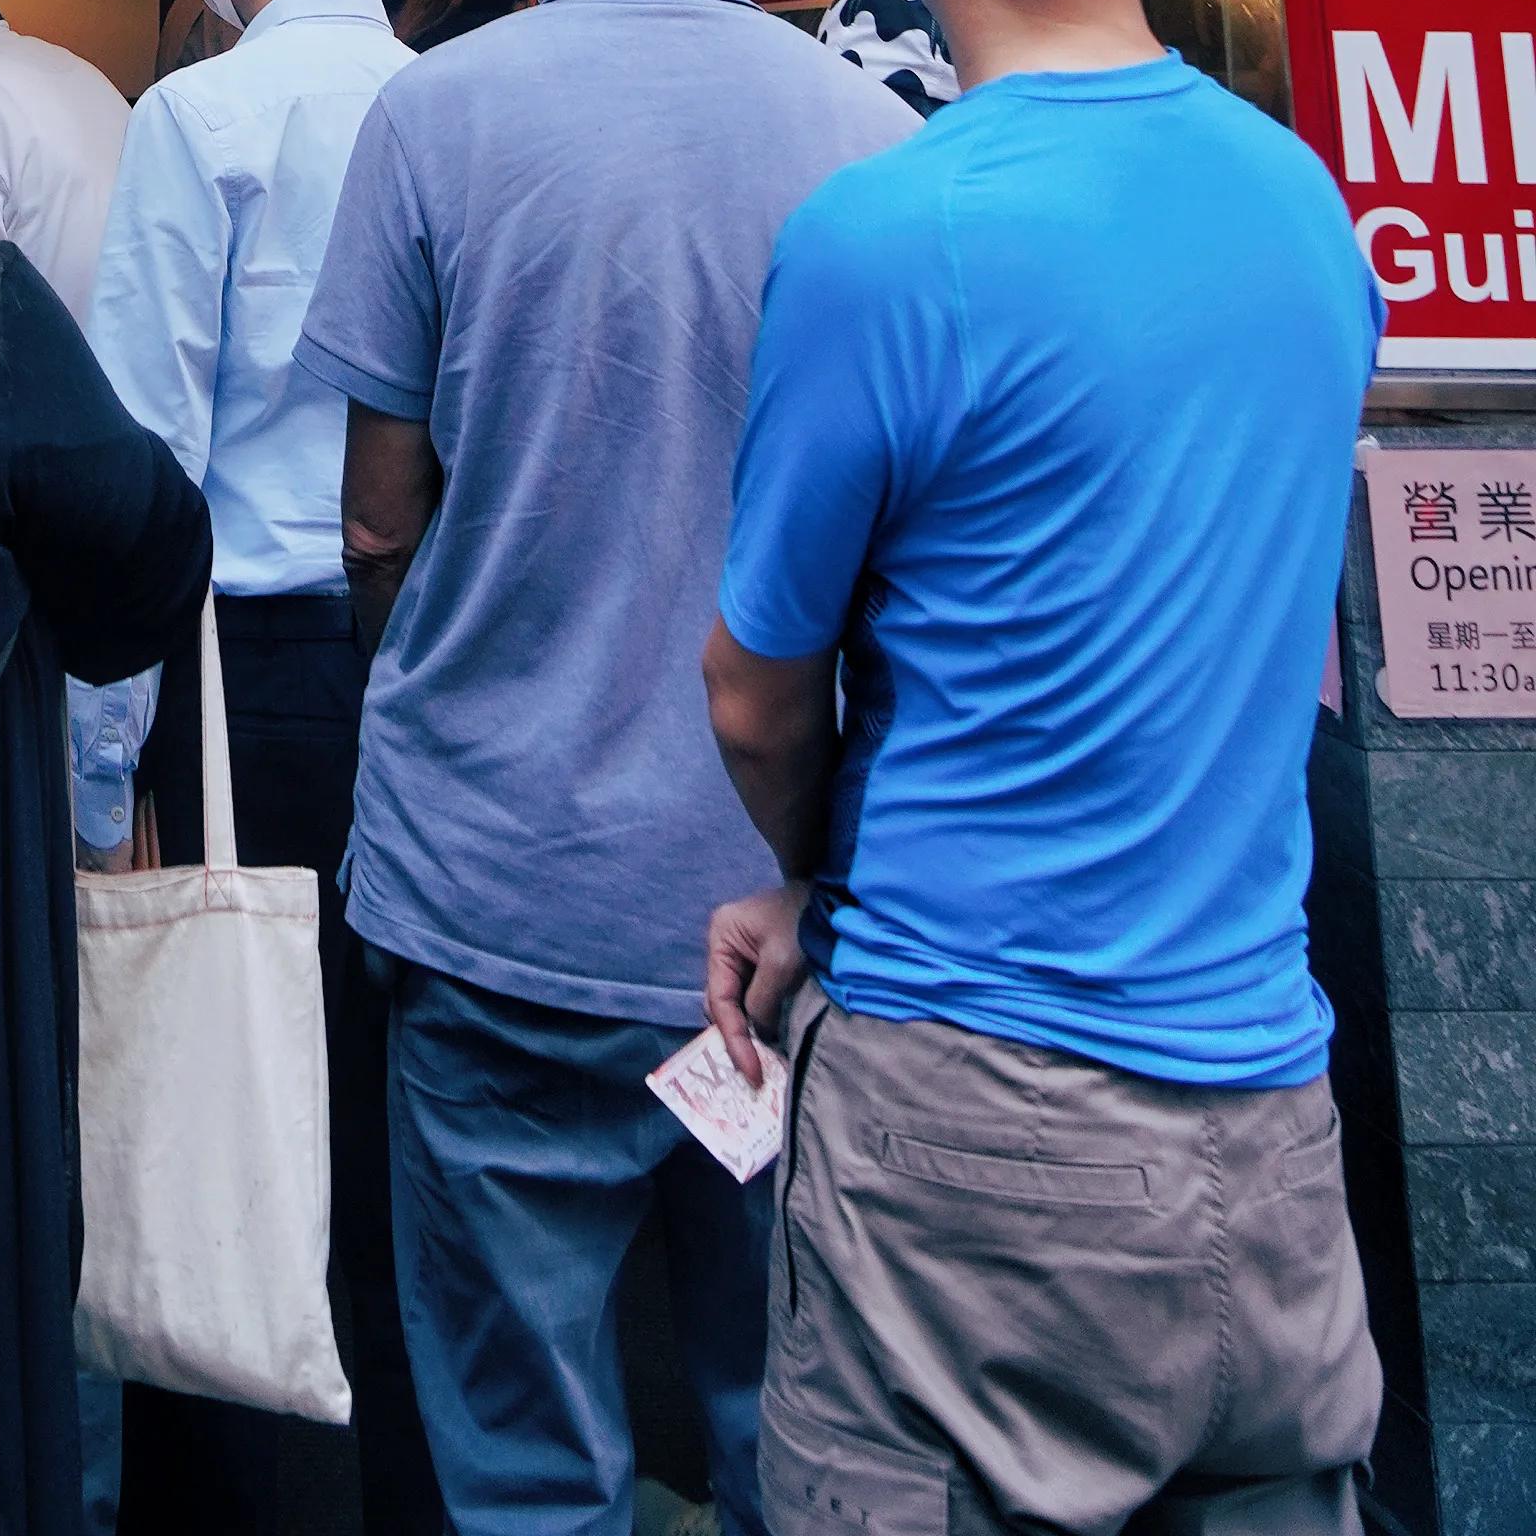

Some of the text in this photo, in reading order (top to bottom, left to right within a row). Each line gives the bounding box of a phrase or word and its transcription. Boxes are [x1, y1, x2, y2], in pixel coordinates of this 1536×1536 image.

[1354, 206, 1536, 303] Gui
[1403, 481, 1536, 543] 營業
[1427, 620, 1536, 650] 星期一至
